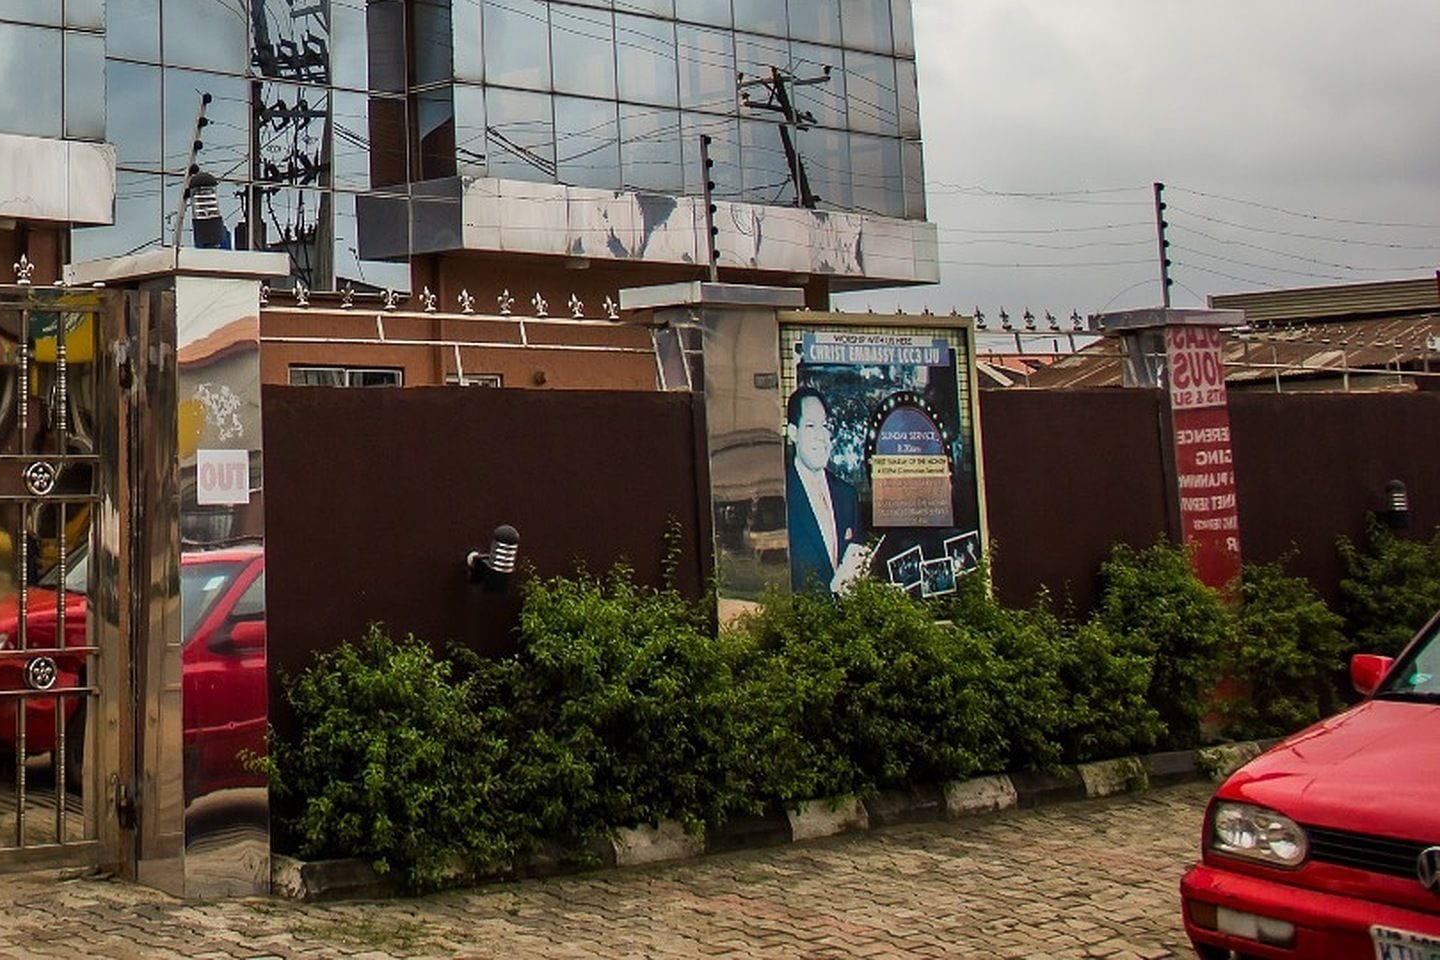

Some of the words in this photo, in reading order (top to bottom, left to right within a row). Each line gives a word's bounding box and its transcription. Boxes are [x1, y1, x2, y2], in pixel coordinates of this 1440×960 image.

[810, 344, 846, 362] CHRIST
[849, 346, 896, 363] EMBASSY
[201, 463, 246, 491] OUT
